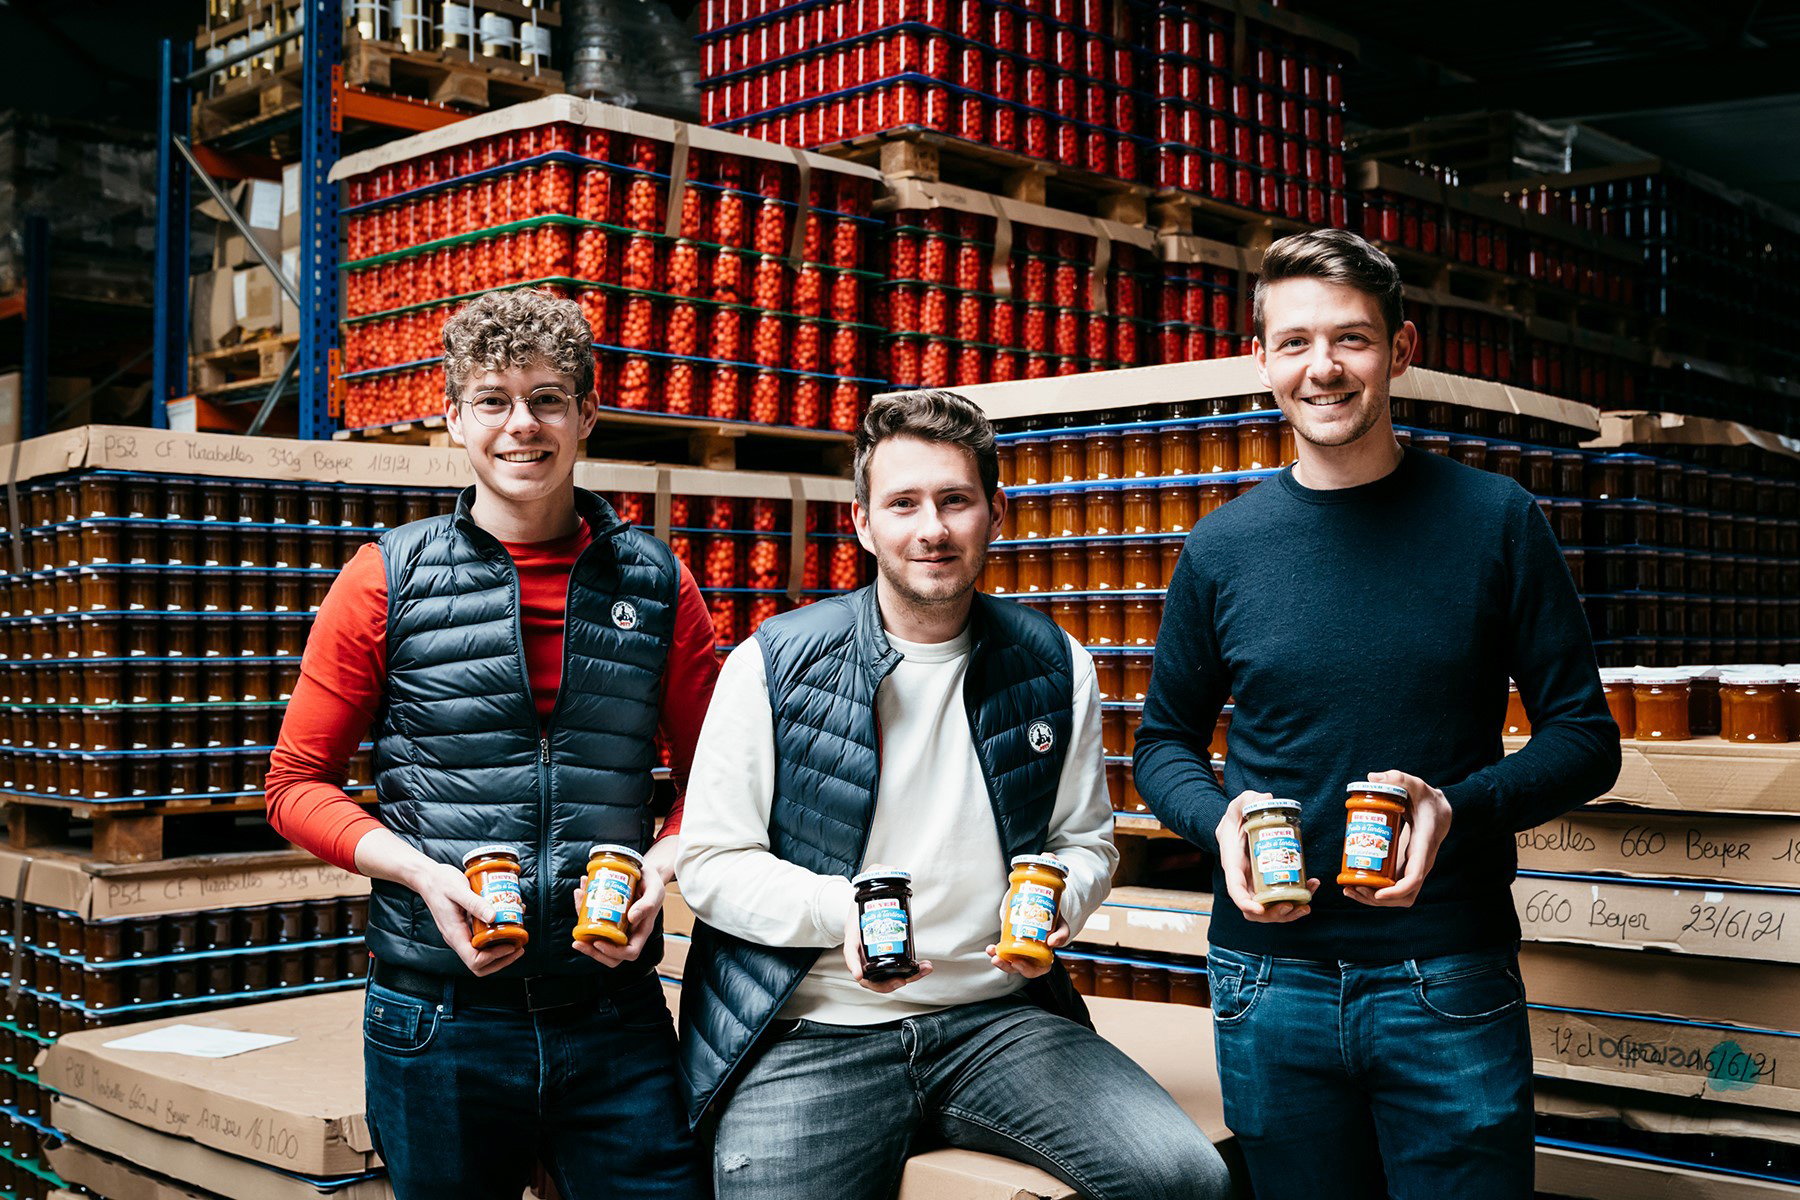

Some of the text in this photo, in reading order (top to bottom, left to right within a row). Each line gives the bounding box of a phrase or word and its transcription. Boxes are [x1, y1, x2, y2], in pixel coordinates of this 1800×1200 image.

[105, 435, 138, 462] P52
[155, 440, 176, 458] CF
[1620, 825, 1666, 857] 660
[108, 883, 147, 908] P51
[163, 879, 185, 899] CF
[1525, 890, 1571, 923] 660
[1682, 905, 1785, 942] 23/6/21
